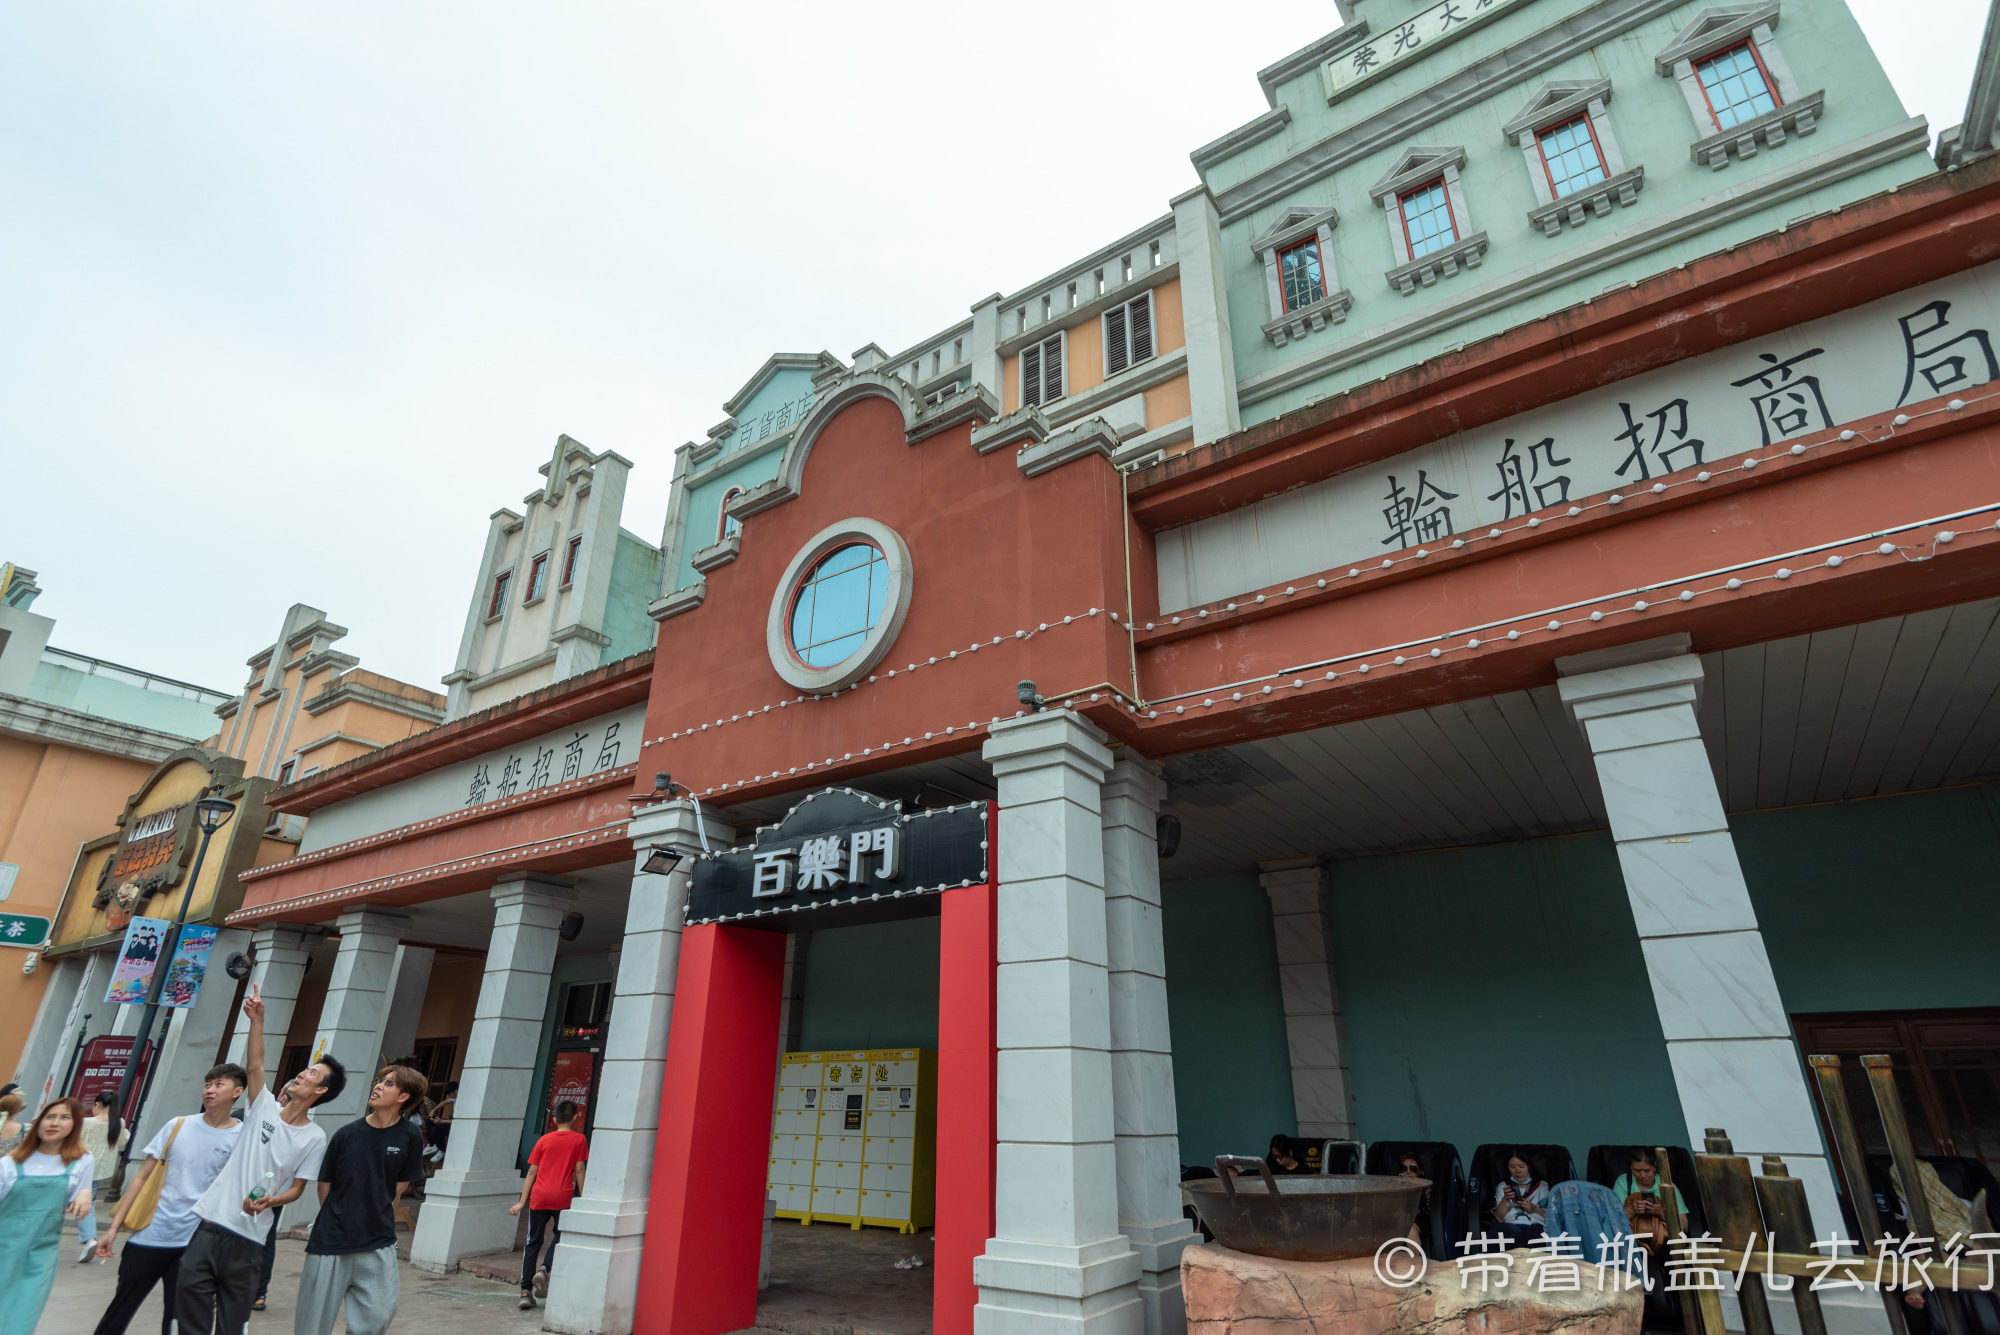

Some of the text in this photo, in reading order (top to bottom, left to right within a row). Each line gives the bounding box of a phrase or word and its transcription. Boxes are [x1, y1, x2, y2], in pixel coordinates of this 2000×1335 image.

[751, 827, 900, 898] 百樂門
[829, 1064, 889, 1083] 寄存处
